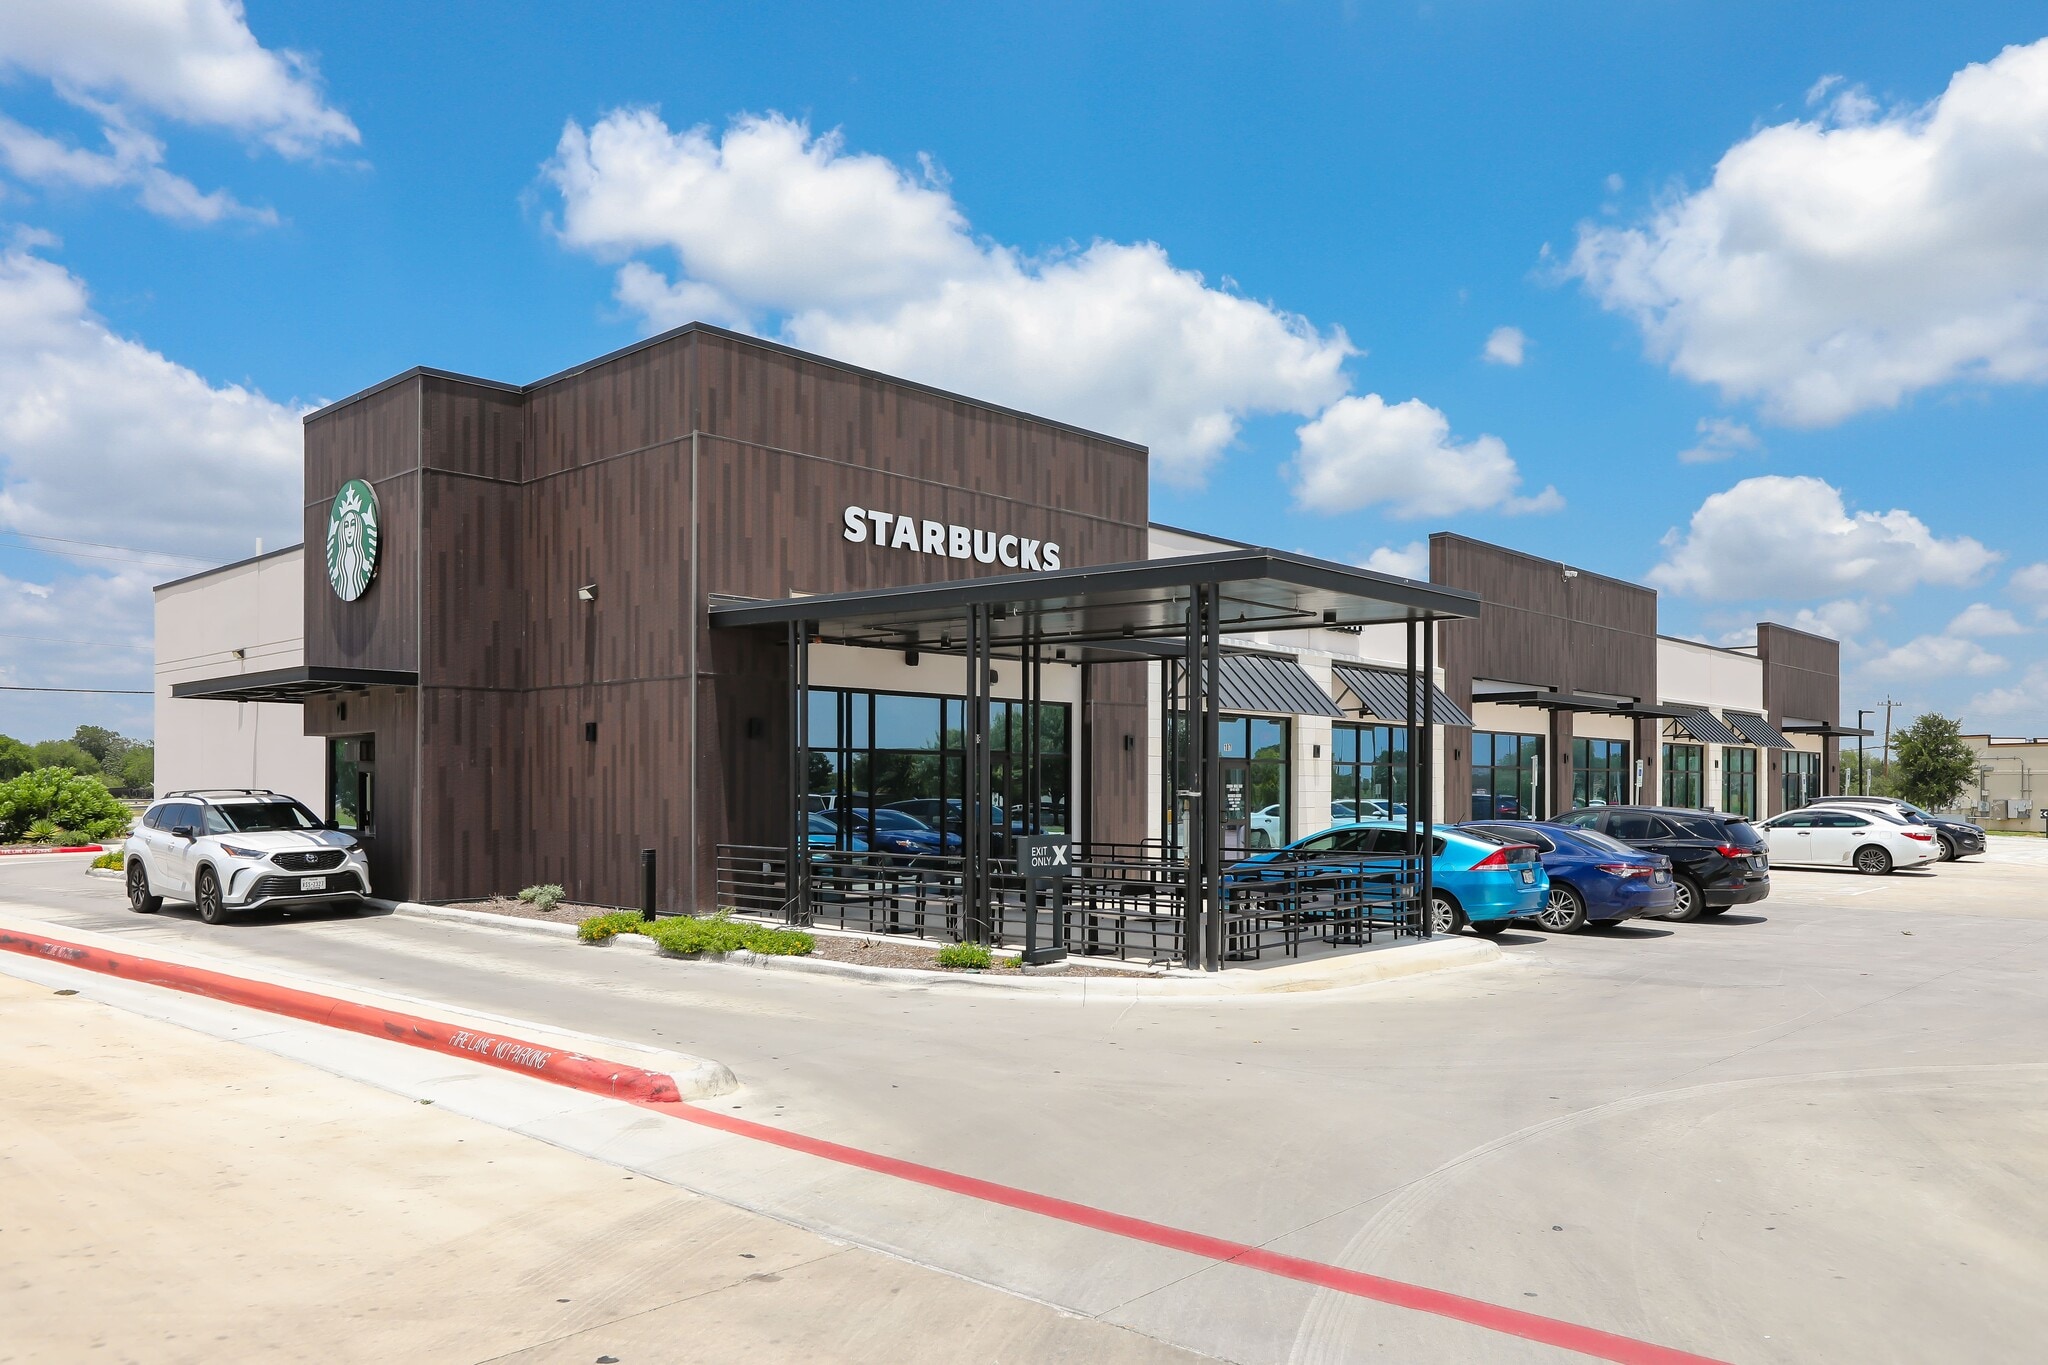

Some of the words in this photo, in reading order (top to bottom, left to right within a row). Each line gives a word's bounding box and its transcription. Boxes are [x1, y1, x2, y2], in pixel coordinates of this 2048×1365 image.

[843, 505, 1061, 571] STARBUCKS
[1031, 846, 1048, 857] EXIT
[1031, 856, 1052, 867] ONLY
[1052, 844, 1068, 866] X
[448, 1030, 474, 1049] FIRE
[467, 1034, 496, 1055] LANE
[492, 1040, 511, 1060] NO
[506, 1044, 552, 1069] PARKING
